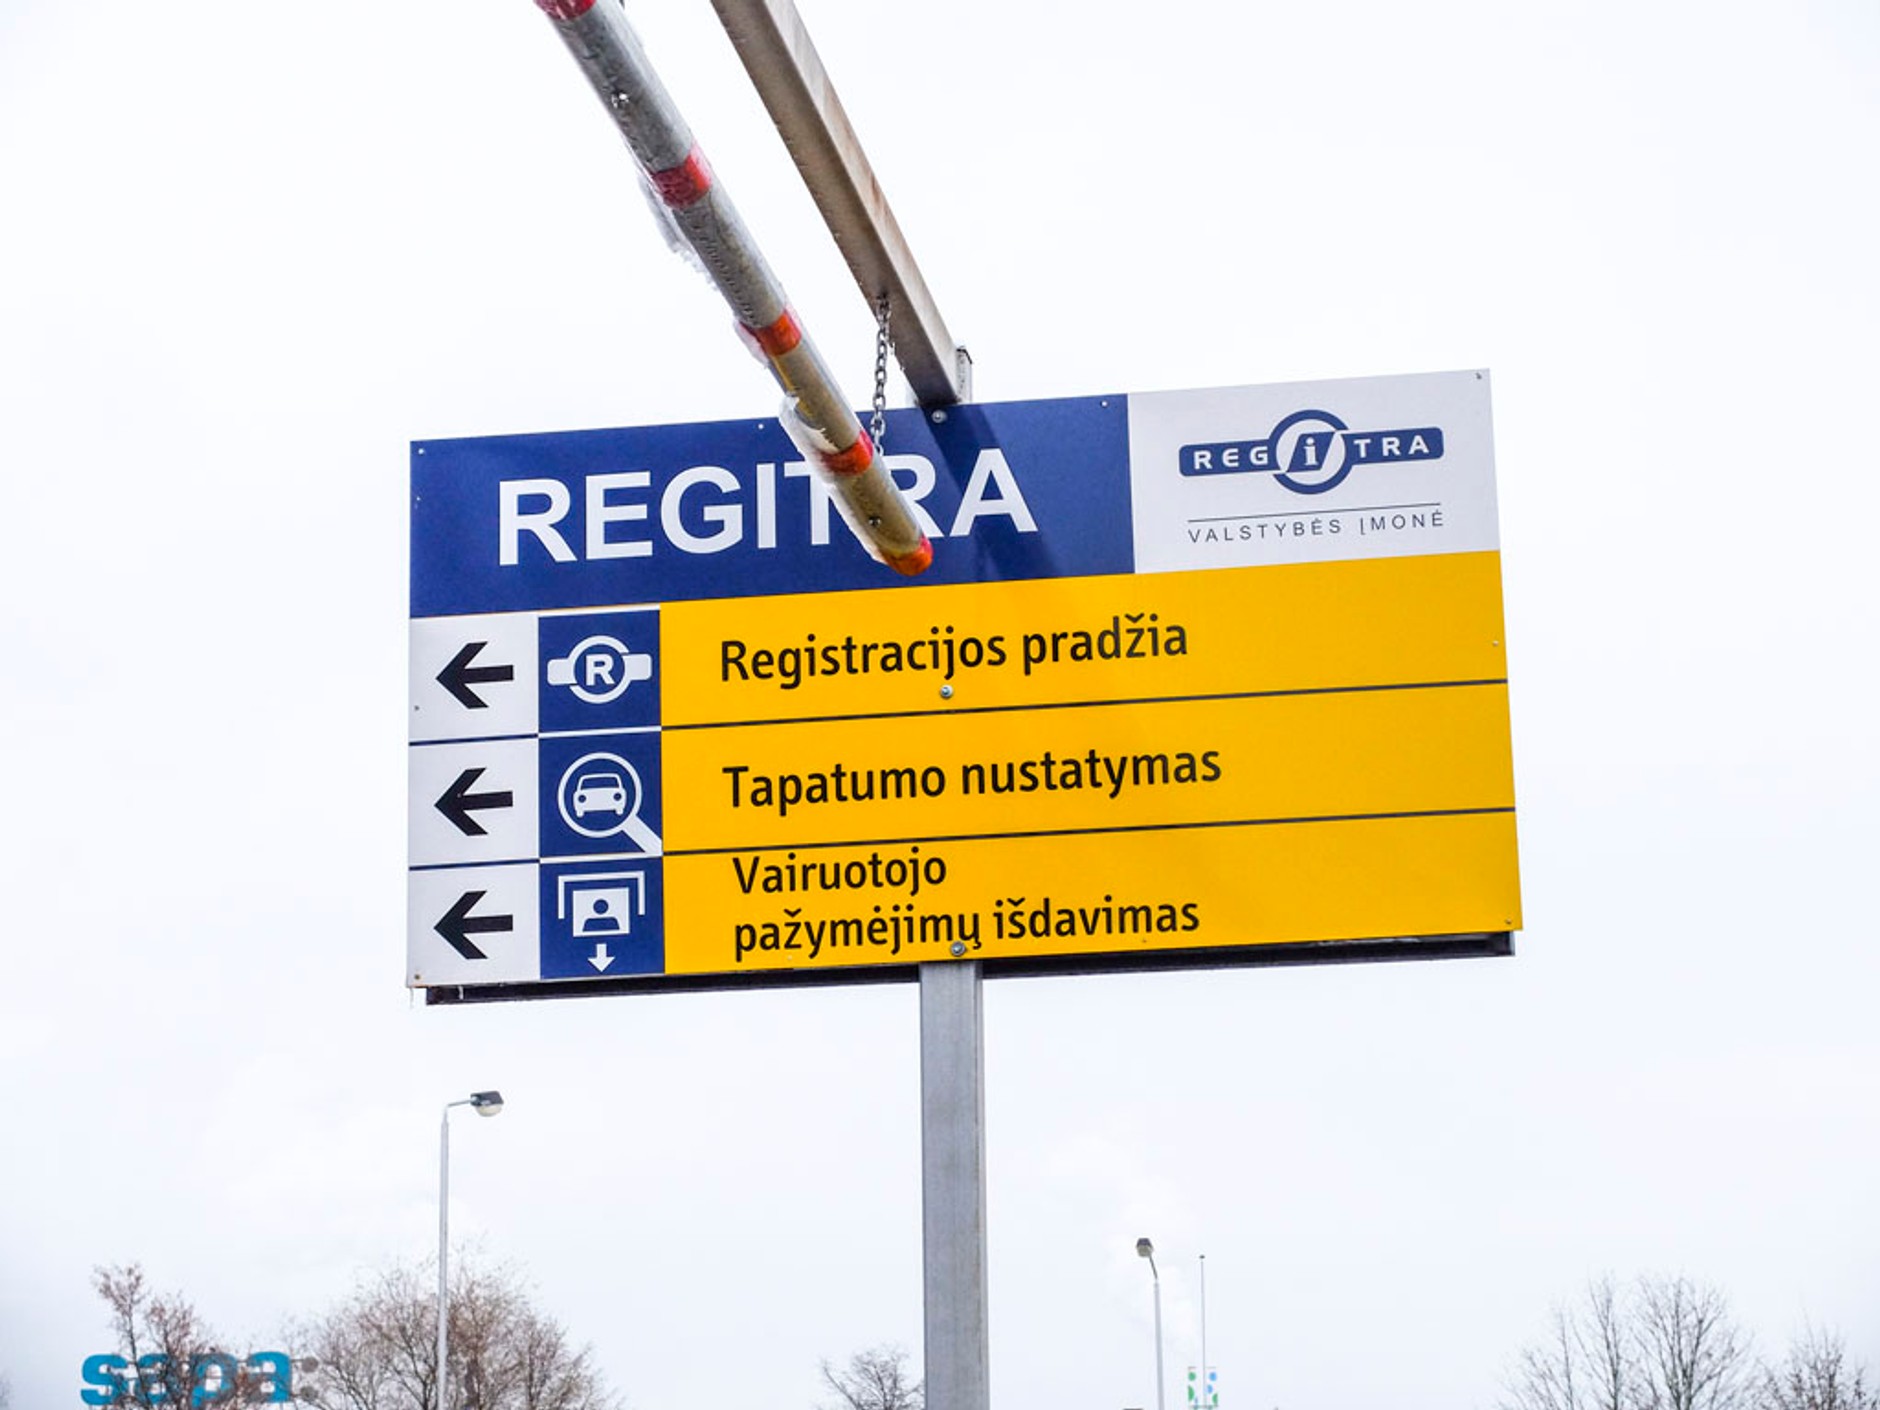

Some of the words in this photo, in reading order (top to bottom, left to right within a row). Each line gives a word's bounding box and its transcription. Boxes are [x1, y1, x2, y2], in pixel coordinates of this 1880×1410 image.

[1193, 436, 1430, 471] REGITRA
[1188, 518, 1341, 543] VALSTYBĖS
[585, 653, 616, 686] R
[720, 626, 1006, 689] Registracijos
[1022, 613, 1188, 676] pradžia
[723, 763, 945, 817] Tapatumo
[961, 749, 1222, 799] nustatymas
[732, 846, 947, 896] Vairuotojo
[735, 902, 982, 962] pažymėjimų
[993, 895, 1201, 941] išdavimas
